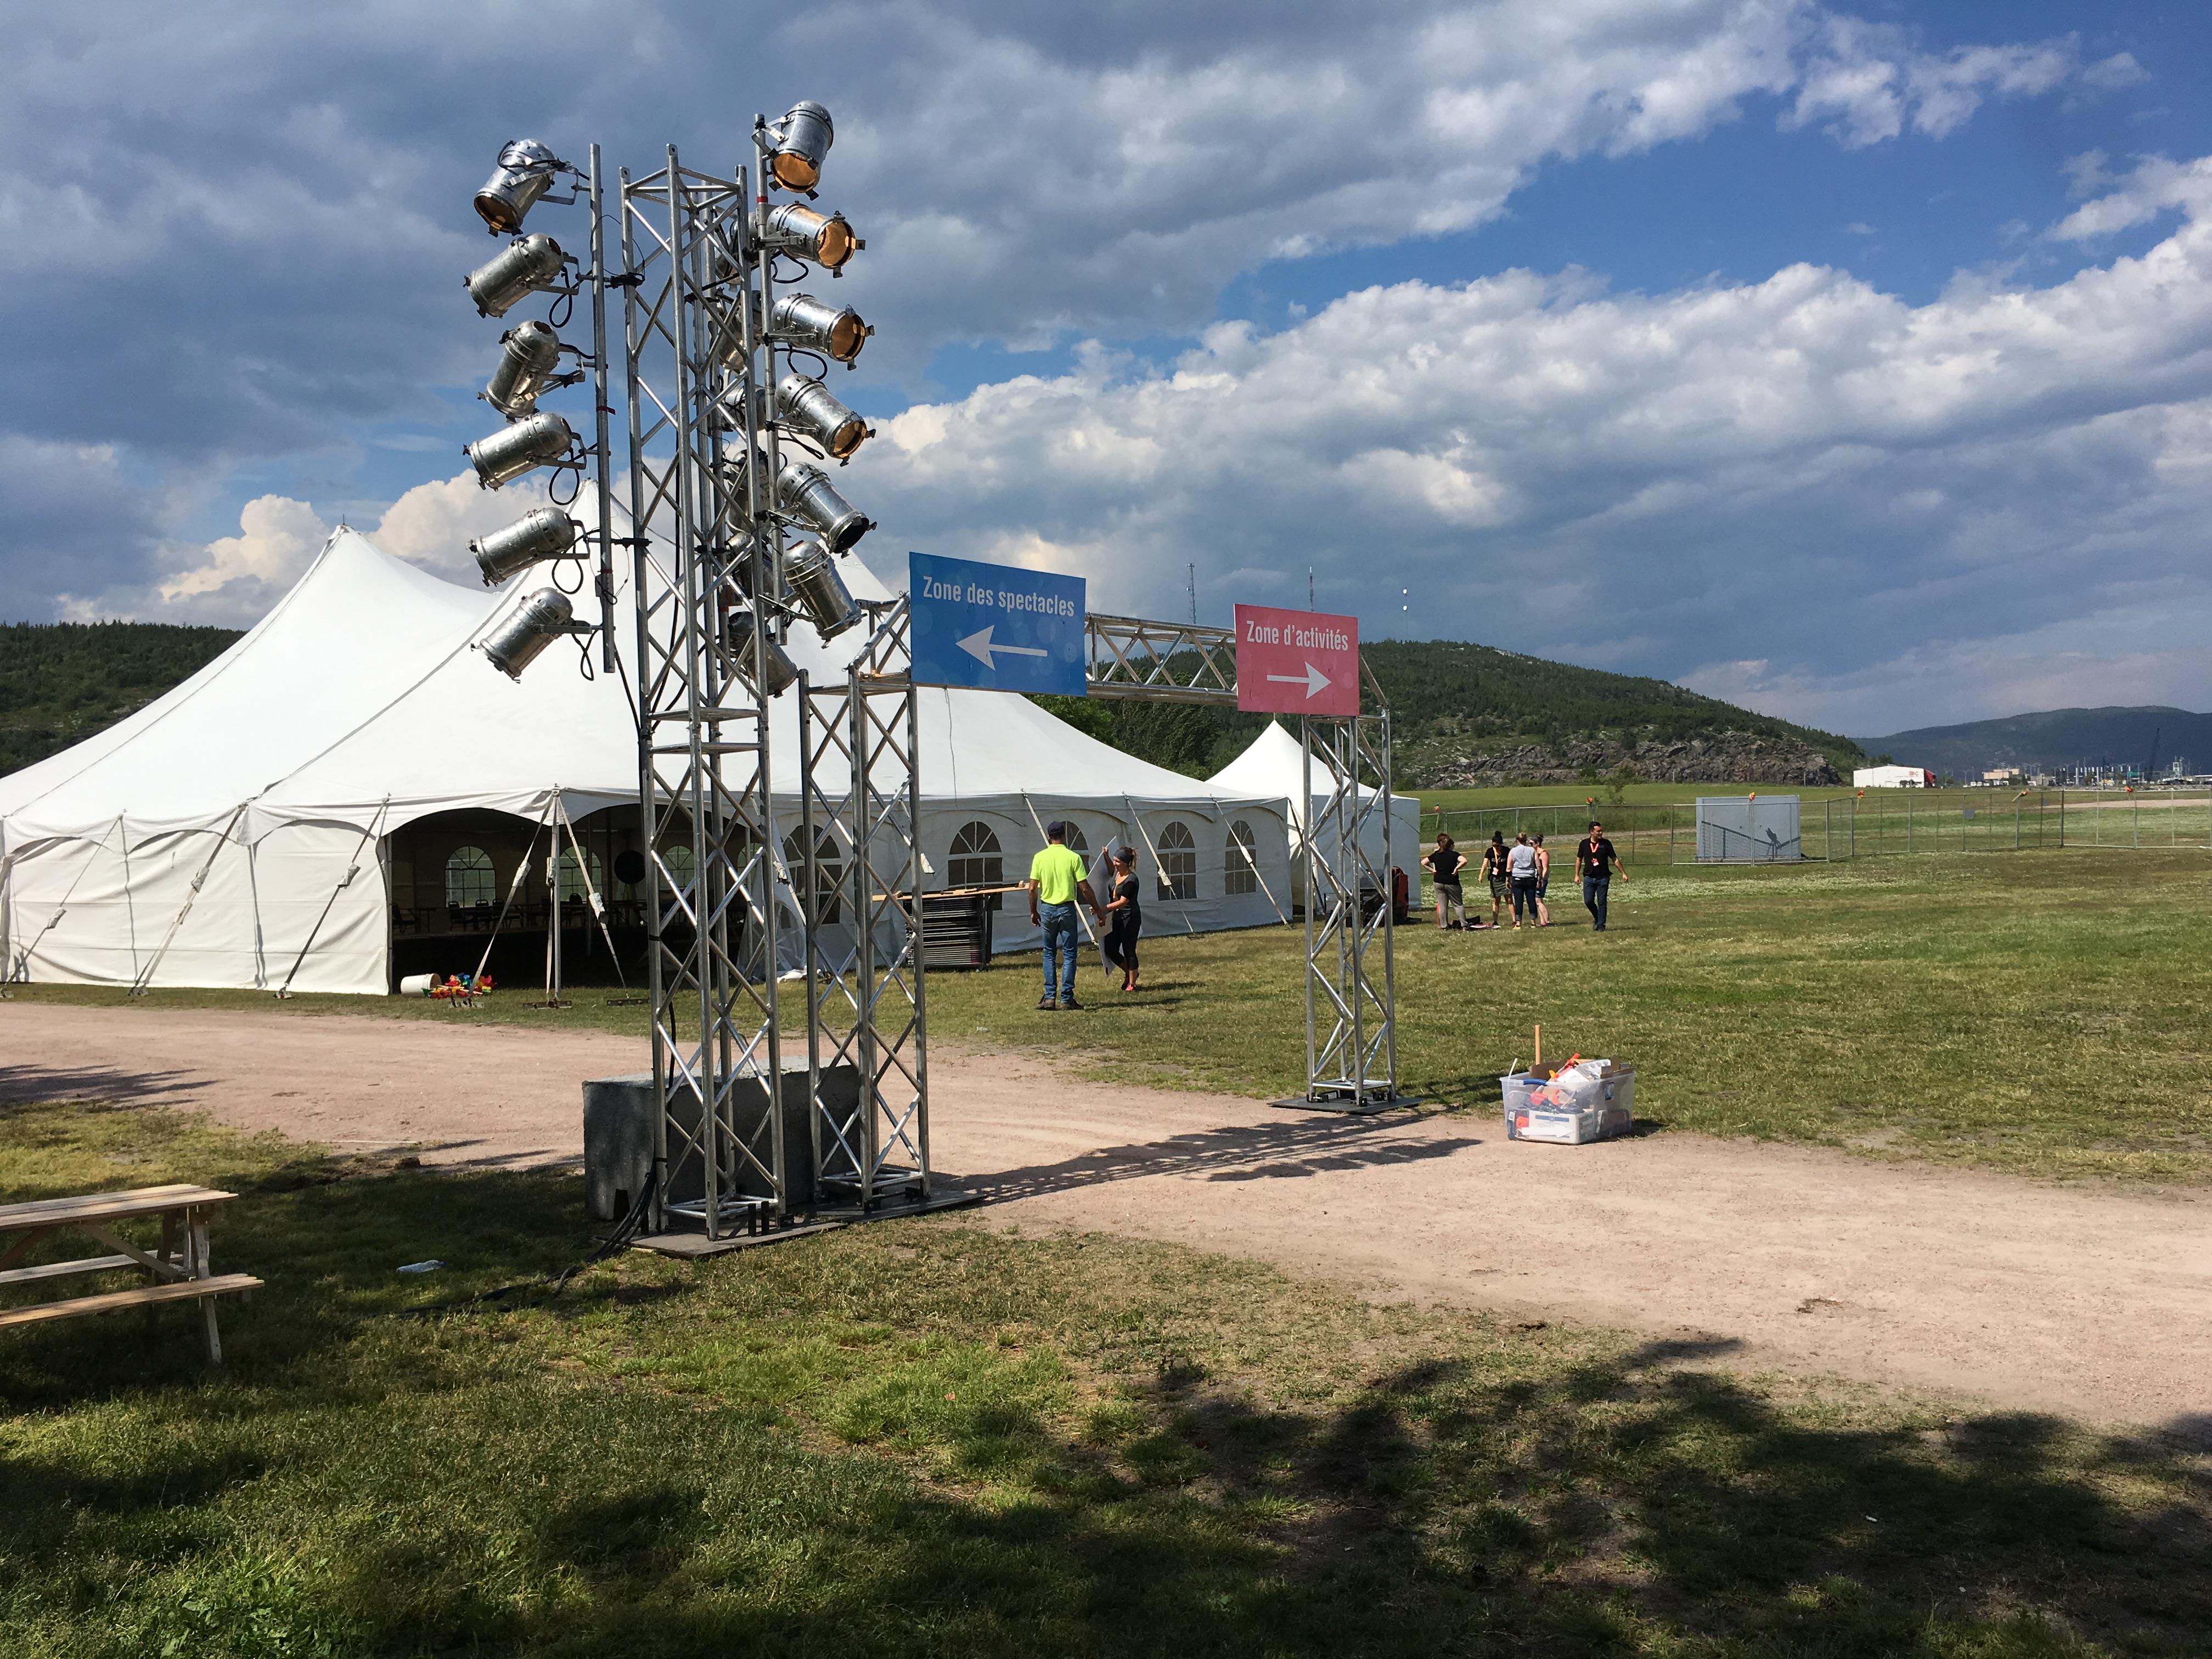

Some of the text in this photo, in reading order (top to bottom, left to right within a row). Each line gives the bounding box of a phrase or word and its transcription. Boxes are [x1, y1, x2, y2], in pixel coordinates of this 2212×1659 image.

[923, 575, 1075, 617] Zone des spectacles
[1246, 620, 1348, 651] Zone d'activités
